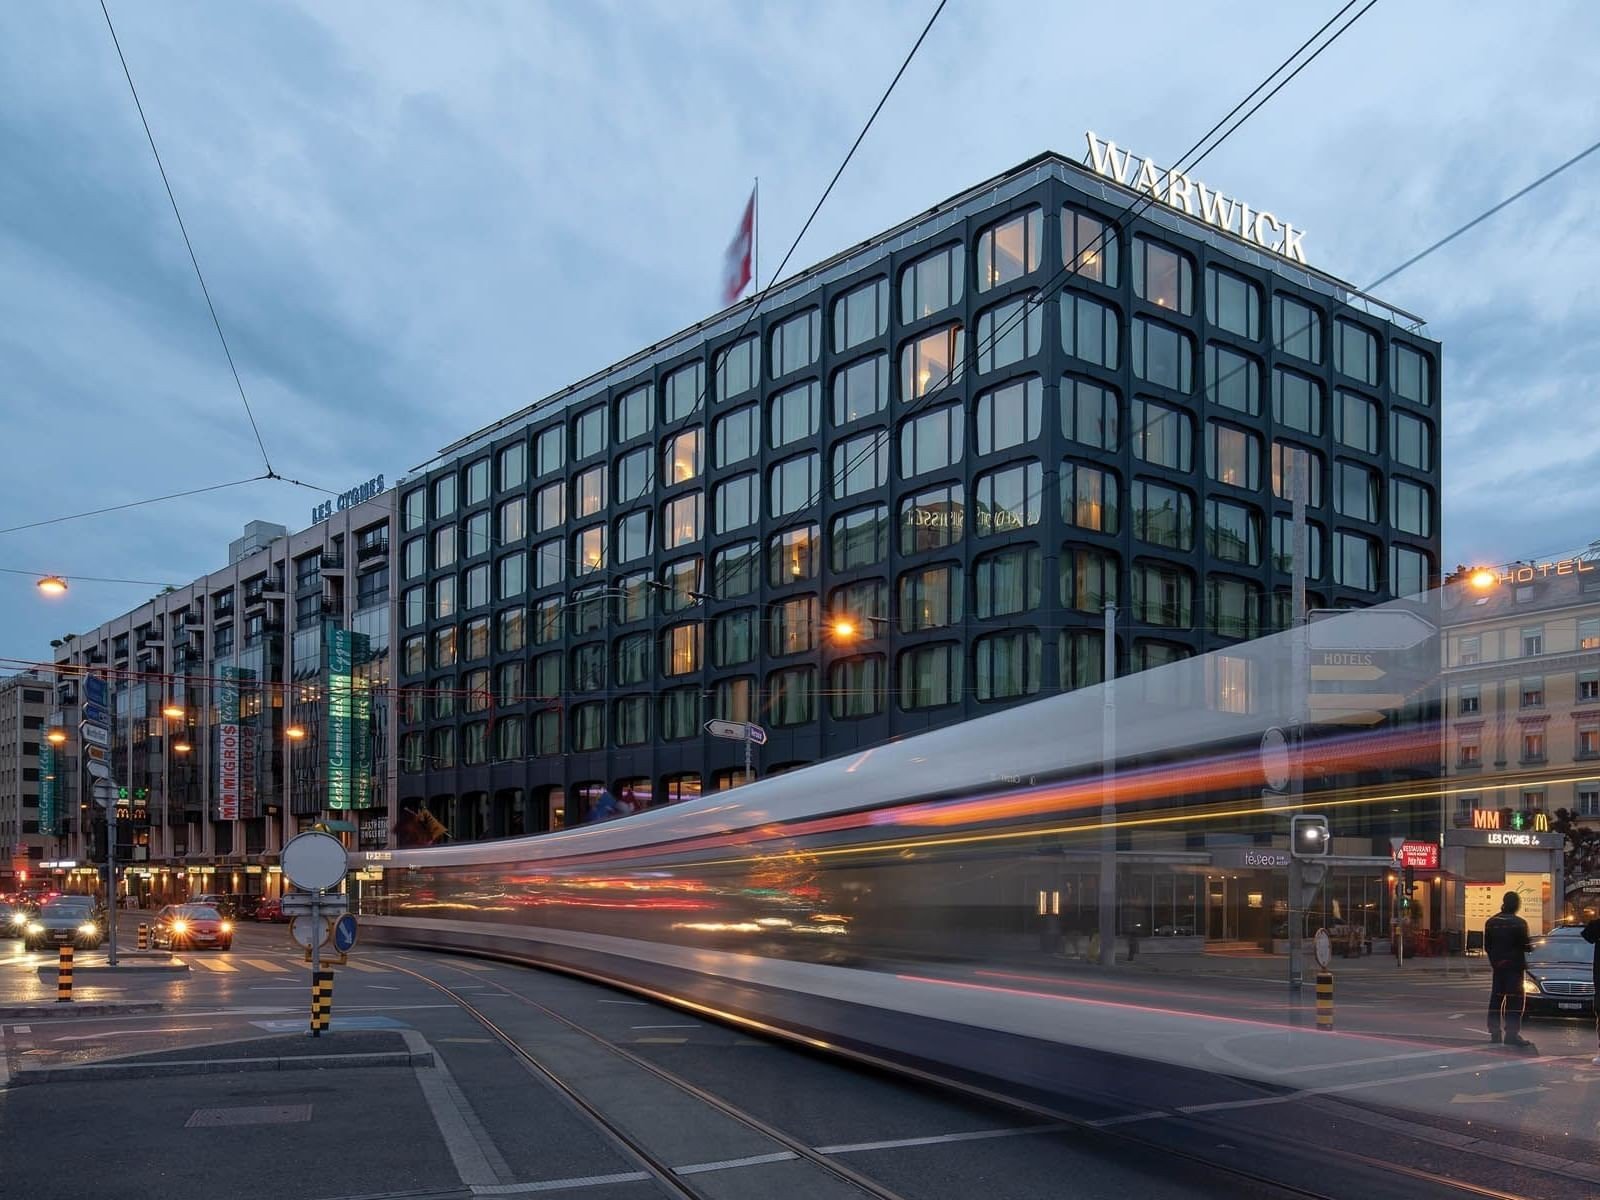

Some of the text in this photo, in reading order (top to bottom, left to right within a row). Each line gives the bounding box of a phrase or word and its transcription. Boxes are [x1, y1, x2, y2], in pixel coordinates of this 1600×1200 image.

[1085, 130, 1307, 265] WARWICK
[312, 473, 385, 524] LES CYGNES
[1498, 558, 1595, 585] HOTEL
[330, 629, 351, 673] Cygnes
[1324, 653, 1373, 665] HOTELS
[329, 698, 343, 768] Commercial
[223, 725, 236, 819] MM MIGROS
[329, 770, 343, 809] Centre
[1473, 809, 1500, 829] MM
[1403, 845, 1431, 853] RESTAURANT
[1488, 834, 1530, 846] LES CYGNES
